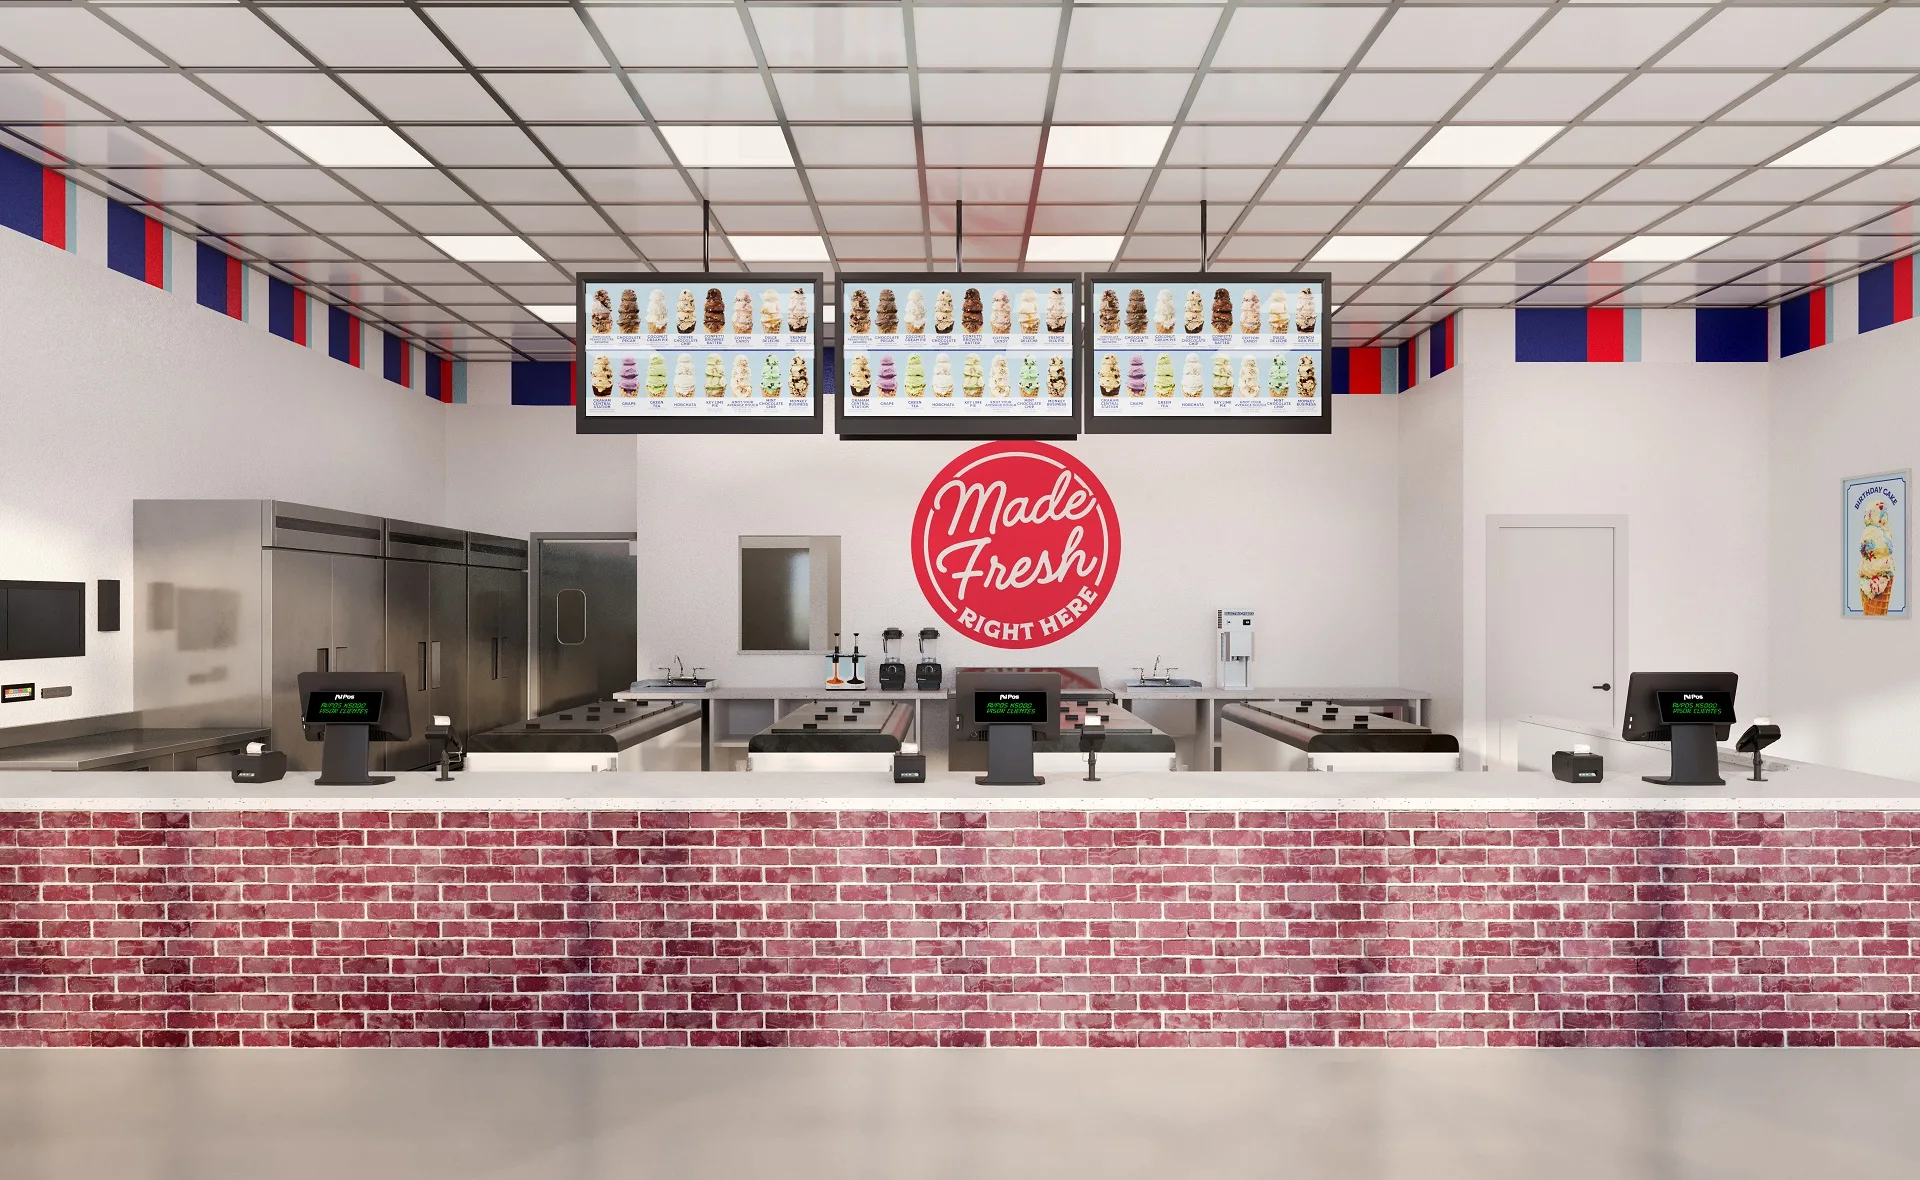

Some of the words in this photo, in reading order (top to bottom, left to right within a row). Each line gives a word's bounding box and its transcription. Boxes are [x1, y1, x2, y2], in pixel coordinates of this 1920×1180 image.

[934, 470, 1097, 536] Made
[1854, 486, 1883, 510] BIRTHDAY
[1882, 488, 1898, 506] CAKE
[936, 525, 1098, 600] Fresh
[957, 606, 1035, 641] RIGHT
[1038, 585, 1098, 637] HERE
